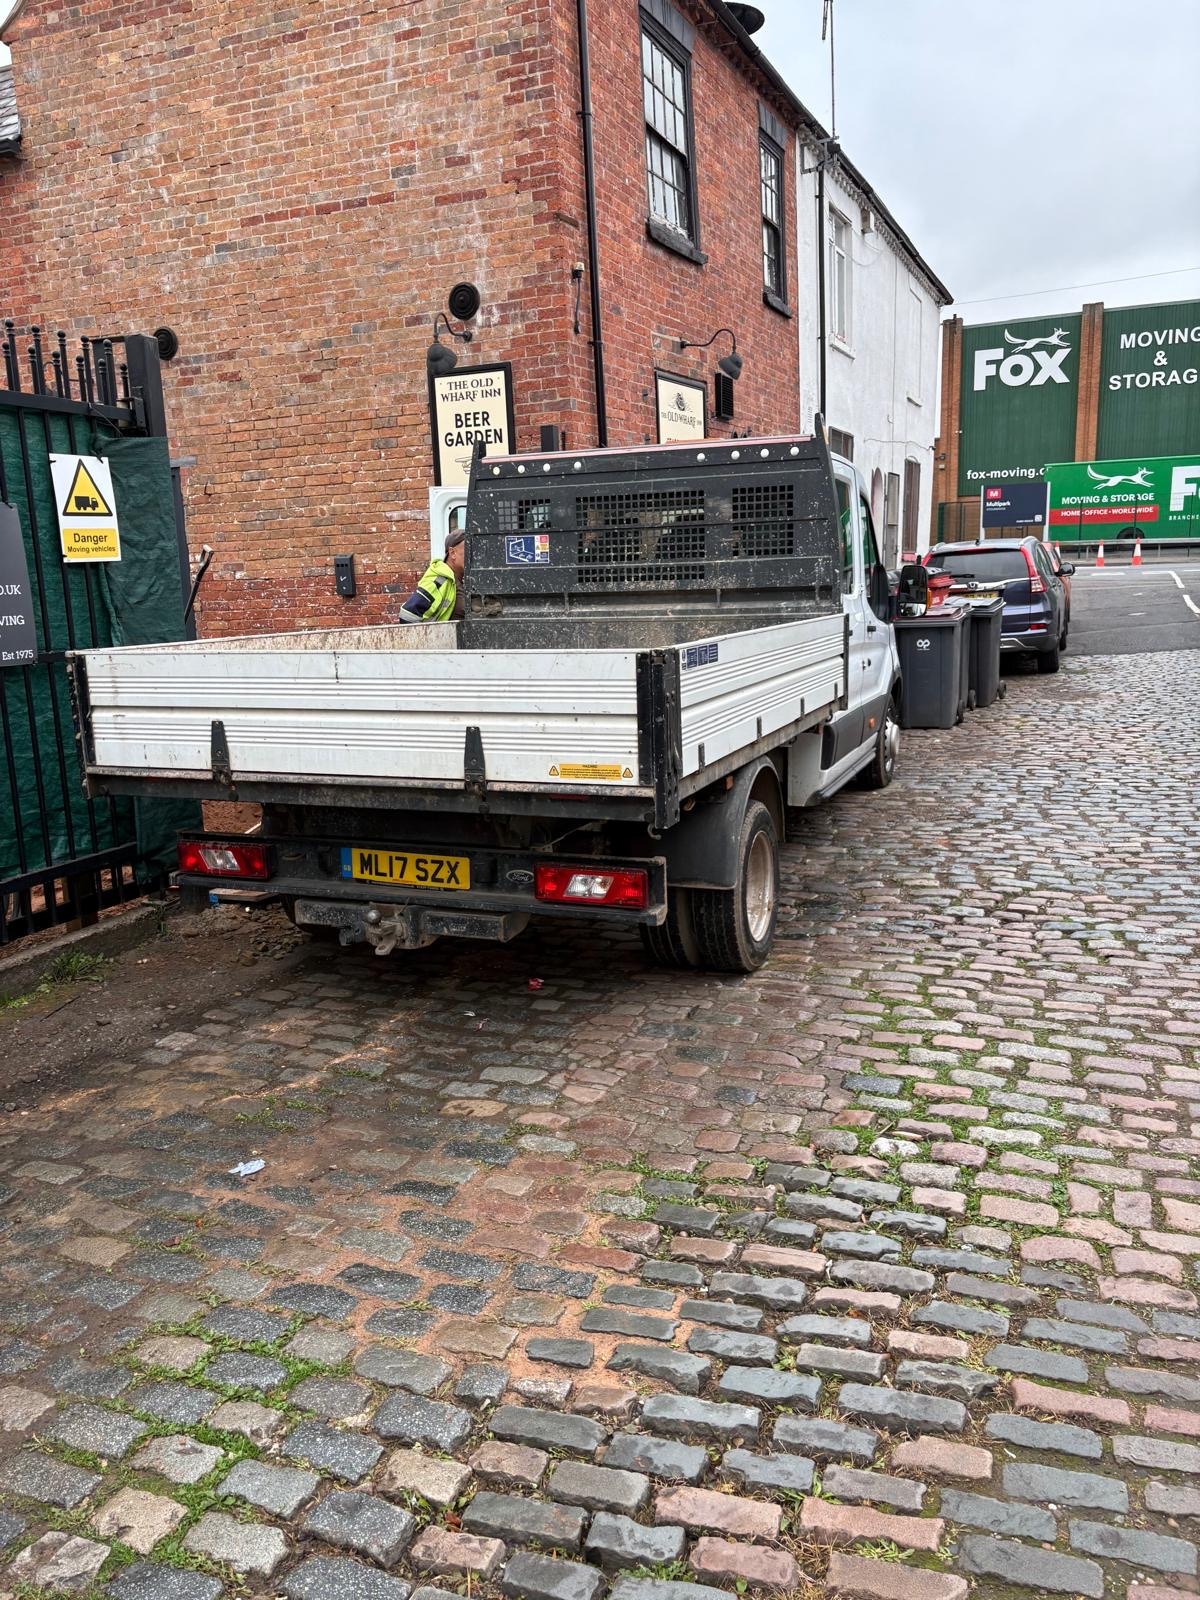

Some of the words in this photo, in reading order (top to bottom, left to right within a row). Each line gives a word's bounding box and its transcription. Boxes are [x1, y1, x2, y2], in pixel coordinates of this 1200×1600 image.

[1120, 326, 1200, 349] MOVING
[1153, 350, 1168, 366] &
[447, 380, 468, 390] THE
[470, 378, 493, 388] OLD
[1108, 368, 1198, 390] STORAG
[441, 390, 477, 402] WHARF
[481, 388, 501, 398] INN
[454, 411, 490, 428] BEER
[668, 411, 678, 422] OLD
[444, 428, 503, 447] GARDEN
[1169, 465, 1200, 511] F
[1061, 495, 1100, 505] MOVING
[1101, 495, 1109, 503] &
[1110, 492, 1155, 502] STORAGE
[1084, 508, 1108, 516] OFFICE
[73, 532, 108, 545] Danger
[67, 546, 90, 554] Moving
[2, 651, 15, 660] Est
[15, 649, 34, 659] 1975
[359, 852, 408, 879] ML17
[415, 858, 460, 885] SZX
